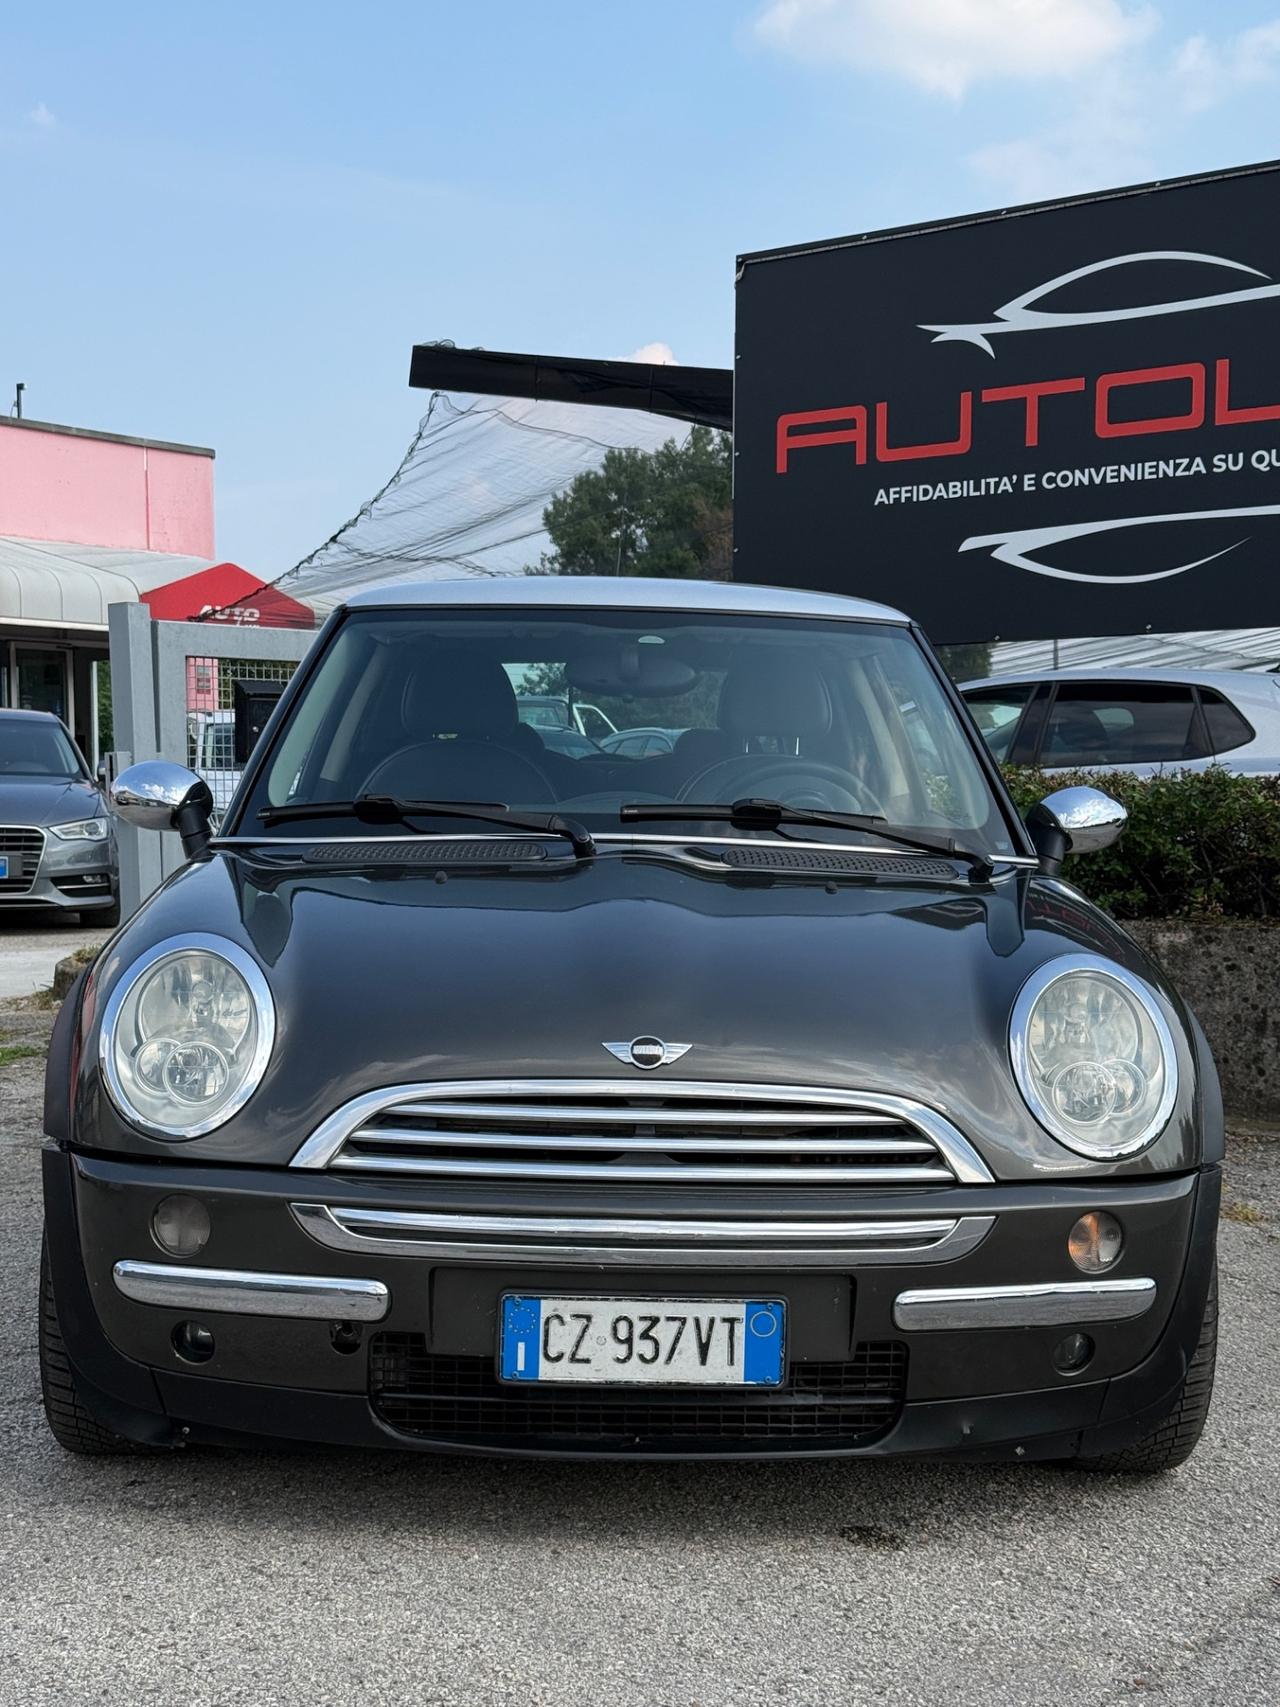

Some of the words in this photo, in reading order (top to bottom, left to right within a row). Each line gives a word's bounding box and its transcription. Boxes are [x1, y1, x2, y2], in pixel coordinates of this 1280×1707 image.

[1023, 473, 1036, 492] E
[1041, 456, 1207, 490] CONVENIENZA
[1212, 451, 1244, 473] SU
